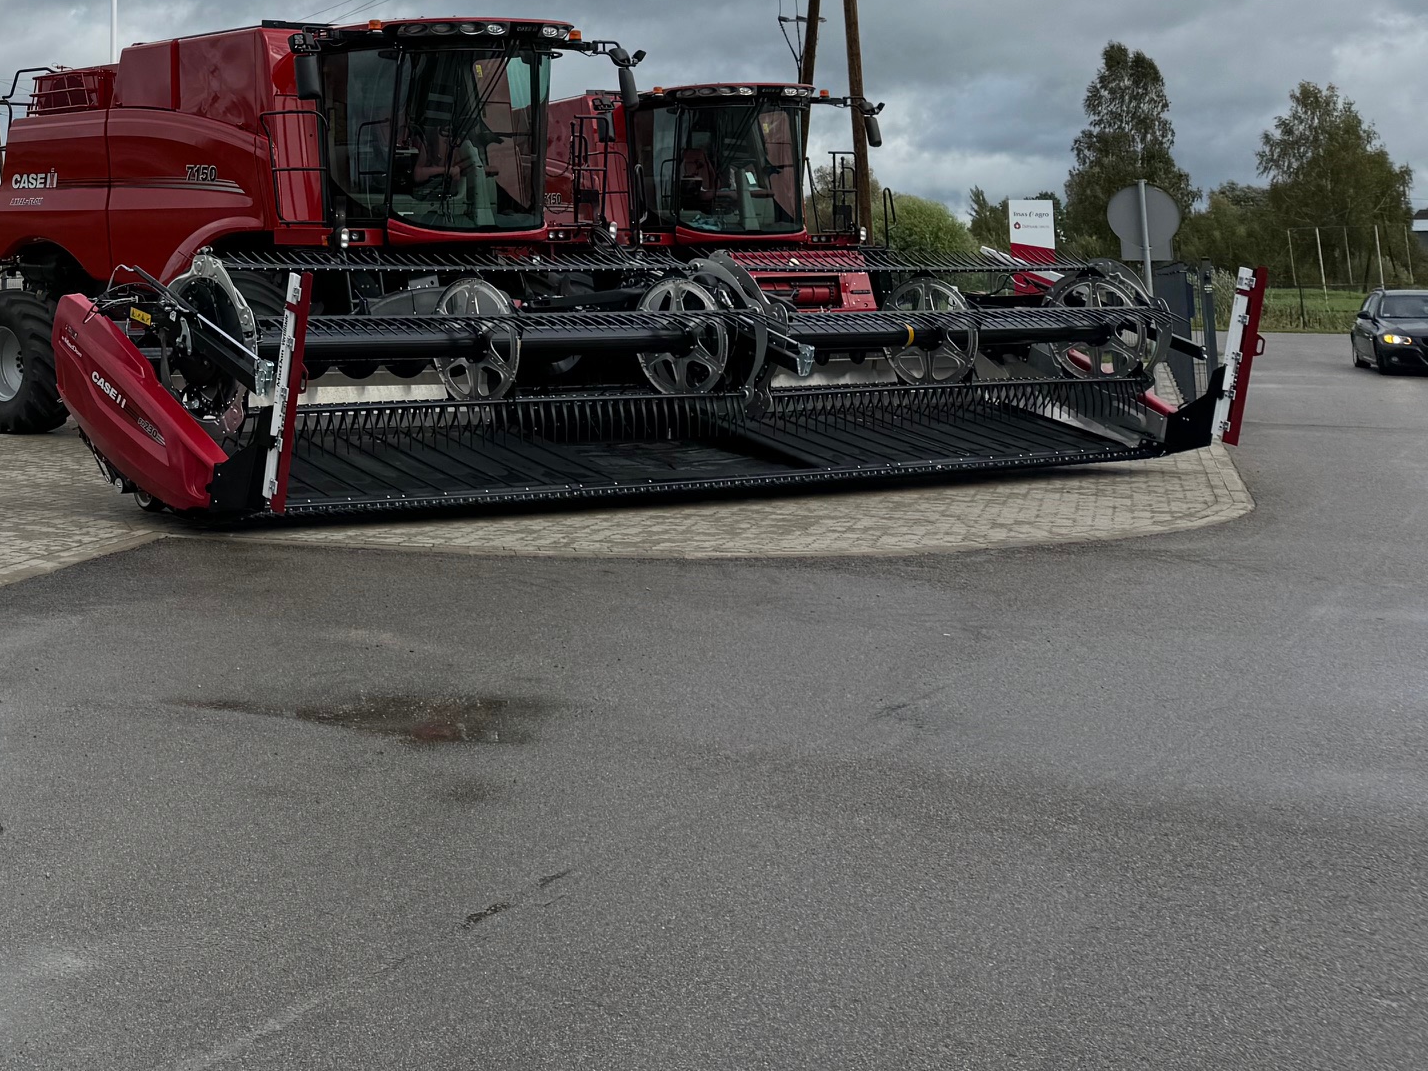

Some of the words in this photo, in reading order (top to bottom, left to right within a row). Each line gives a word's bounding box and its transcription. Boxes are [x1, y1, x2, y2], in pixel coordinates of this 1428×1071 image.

[11, 173, 46, 189] CASE
[185, 164, 218, 181] 7150
[91, 370, 119, 401] CASE
